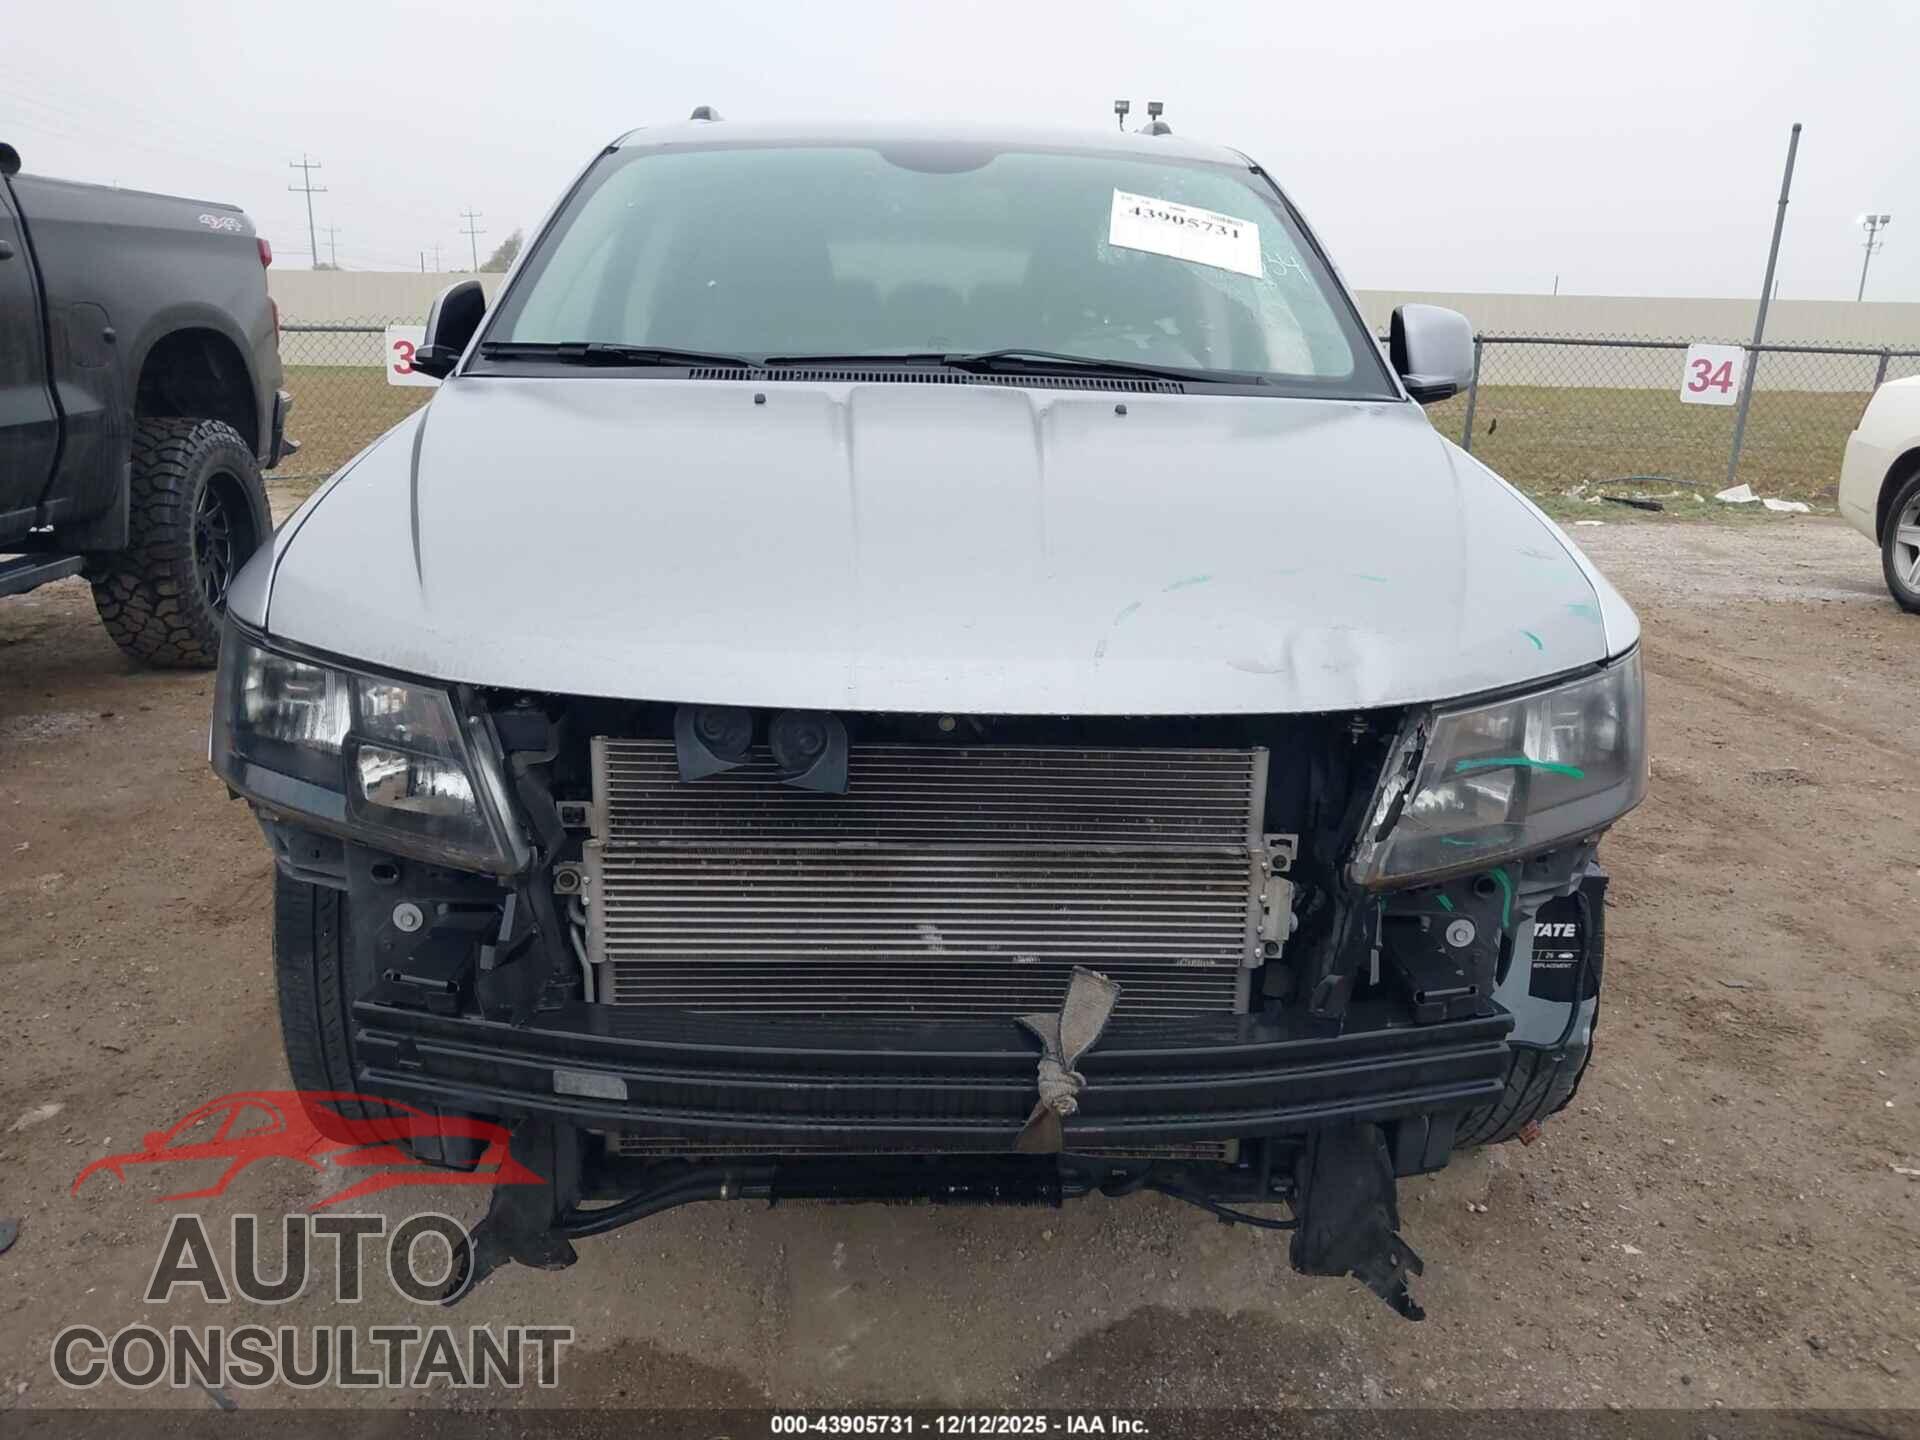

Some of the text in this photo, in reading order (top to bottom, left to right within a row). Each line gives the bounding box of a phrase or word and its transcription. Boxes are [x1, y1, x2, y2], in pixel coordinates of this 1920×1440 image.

[1129, 206, 1239, 239] 43905731
[393, 340, 416, 375] 3
[1687, 358, 1734, 394] 34
